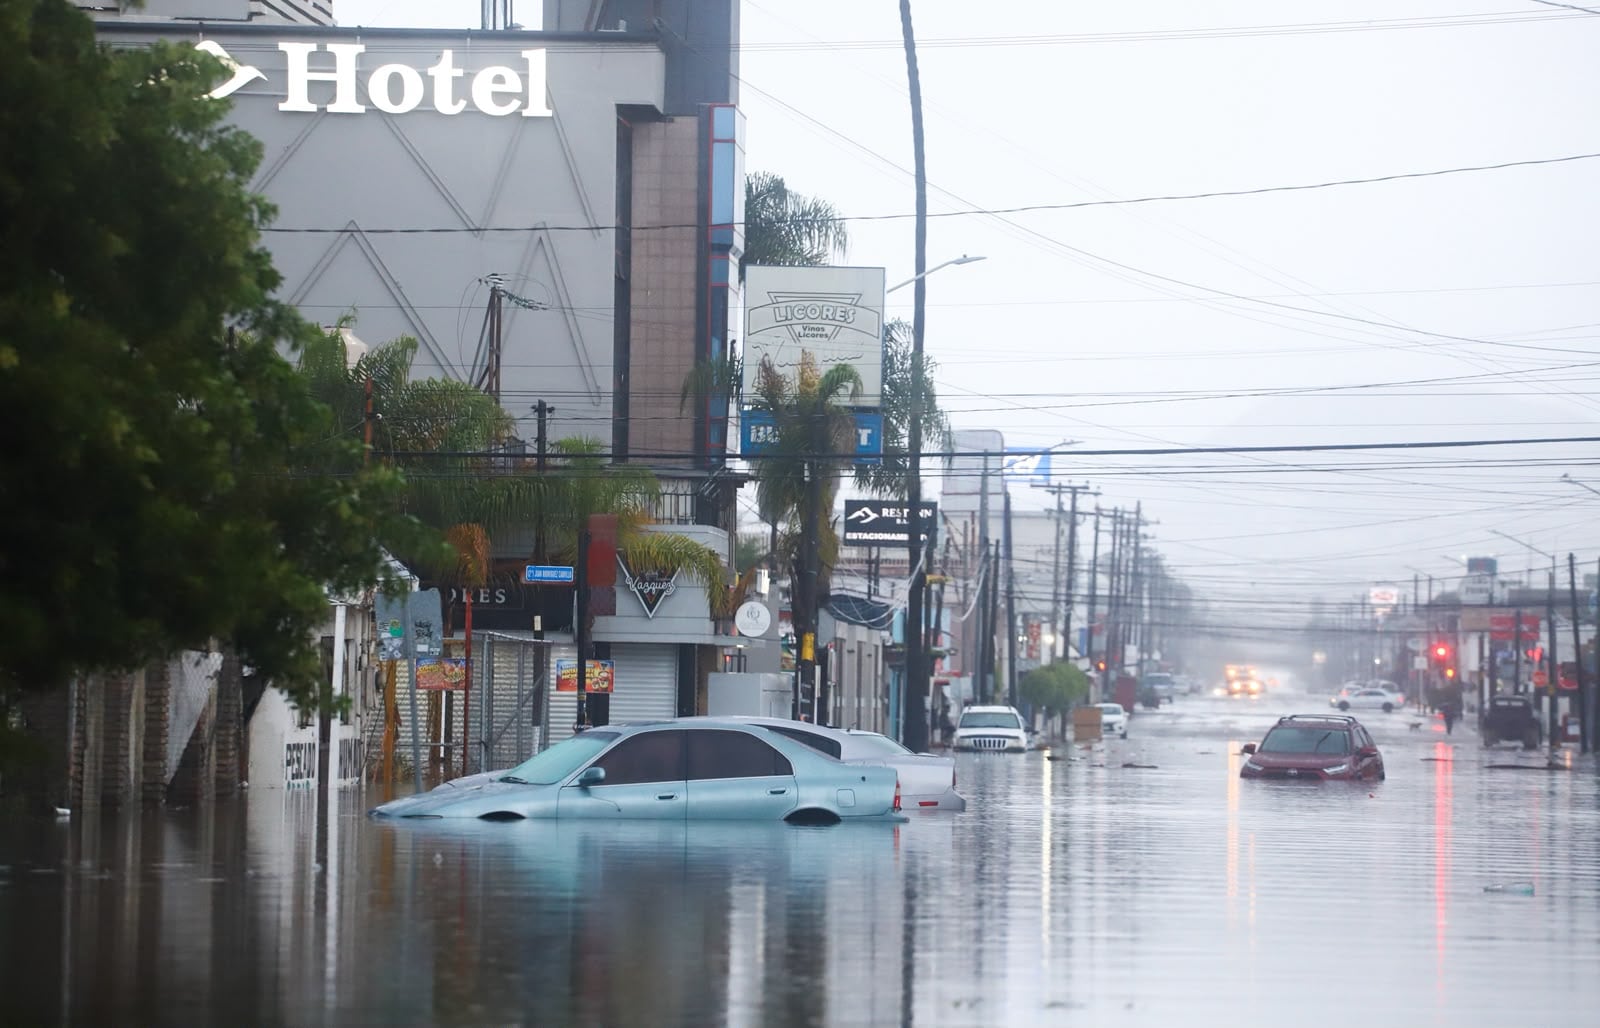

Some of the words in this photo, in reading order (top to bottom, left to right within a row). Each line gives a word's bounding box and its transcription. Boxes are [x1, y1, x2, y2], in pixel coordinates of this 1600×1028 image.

[278, 42, 552, 117] Hotel
[773, 304, 857, 324] LICORES
[798, 331, 829, 339] Licores
[626, 576, 676, 596] Vazquez
